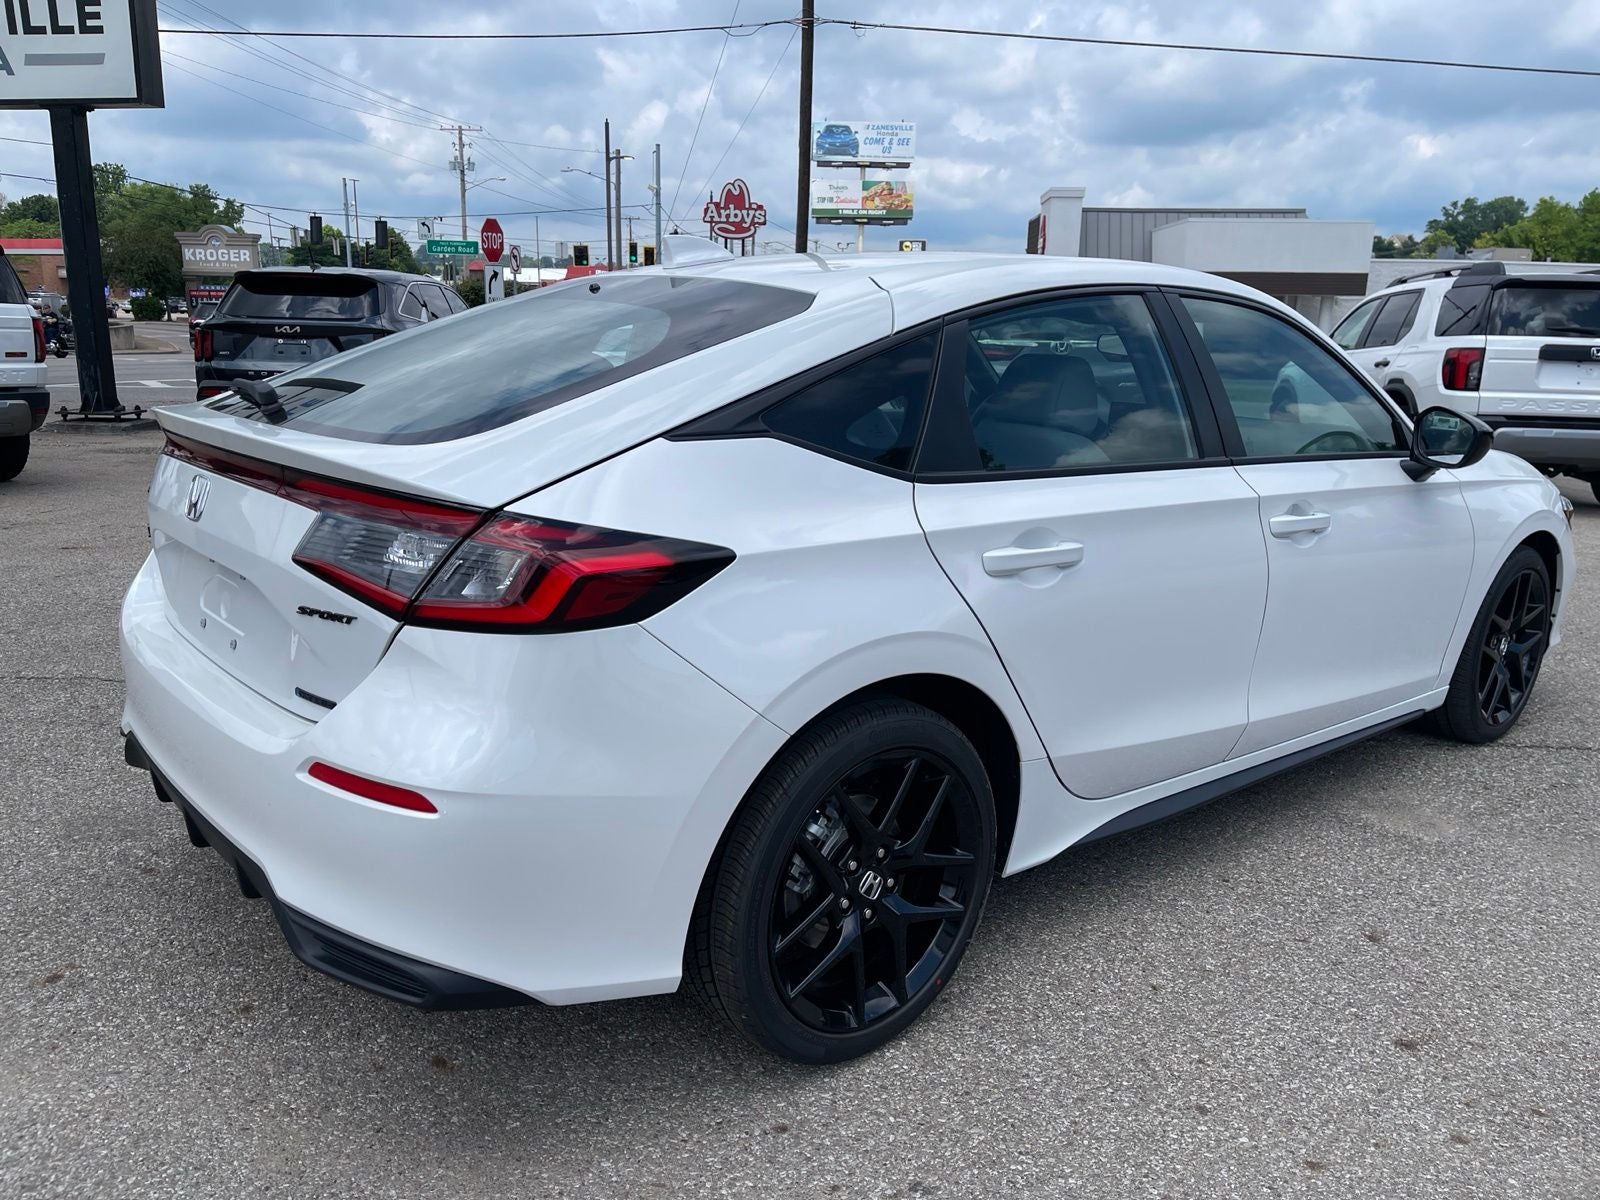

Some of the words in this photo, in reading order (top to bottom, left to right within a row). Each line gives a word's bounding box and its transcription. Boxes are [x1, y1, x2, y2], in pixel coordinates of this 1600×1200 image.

[4, 0, 104, 35] ILLE
[863, 136, 886, 145] COME
[888, 137, 894, 145] &
[896, 137, 911, 146] SEE
[881, 145, 892, 154] US
[704, 203, 767, 229] Arby's
[482, 232, 502, 249] STOP
[184, 248, 251, 262] KROGER
[296, 605, 358, 625] SPORT
